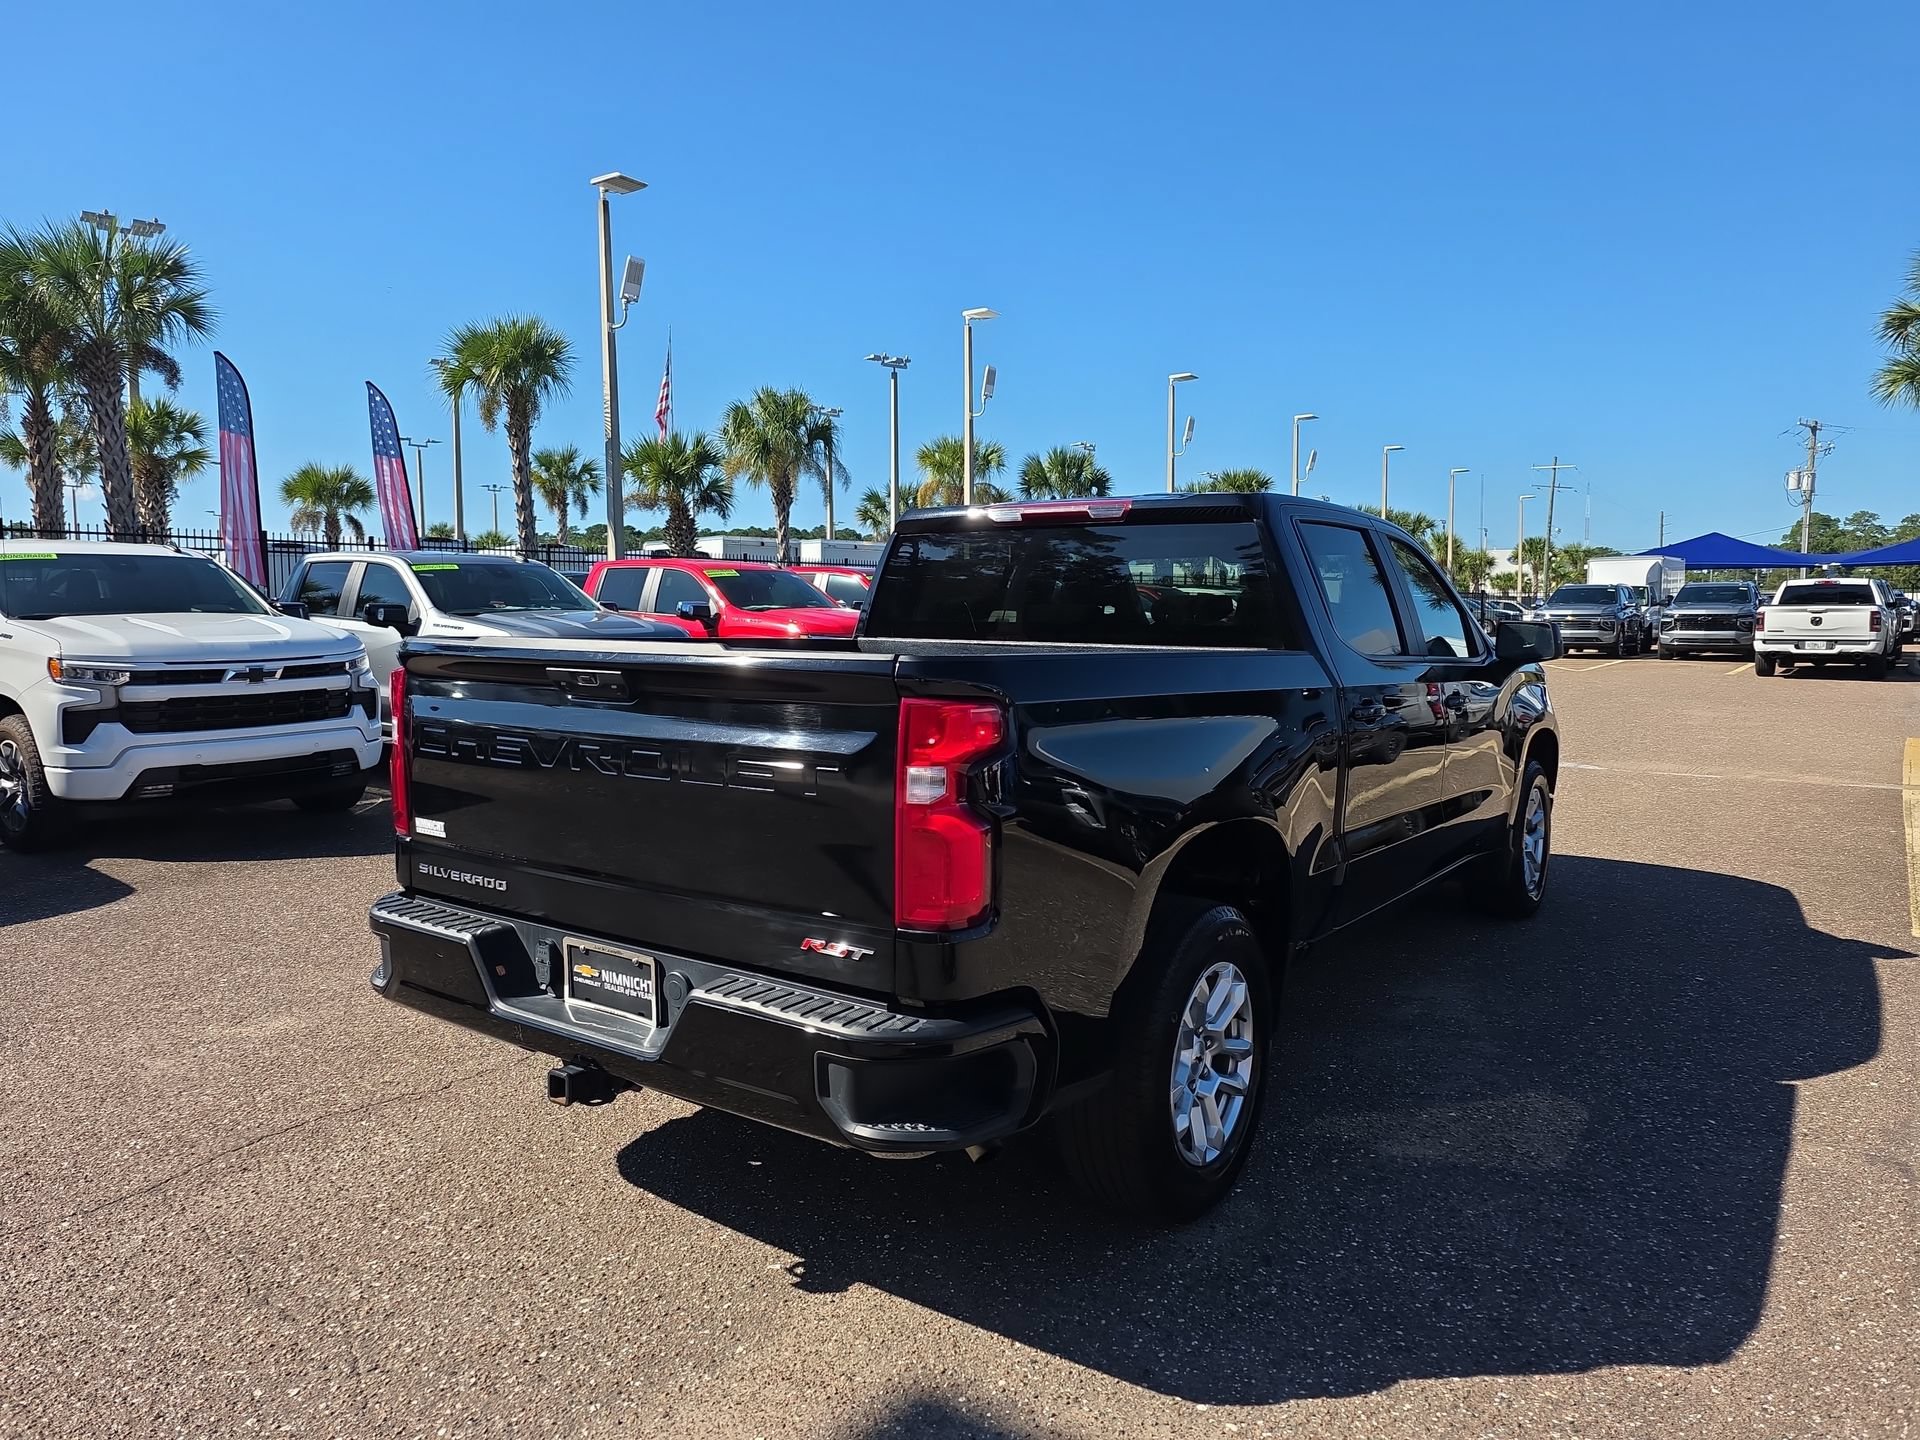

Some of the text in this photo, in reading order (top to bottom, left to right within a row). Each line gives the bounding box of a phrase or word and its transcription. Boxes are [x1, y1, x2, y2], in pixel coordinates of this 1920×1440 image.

[417, 722, 843, 797] CHEVROLET
[419, 863, 507, 891] SILVERADO
[800, 937, 875, 960] RST
[573, 976, 601, 988] CHEVROLET
[601, 969, 652, 993] NIMNICHT
[604, 982, 625, 994] DEALER
